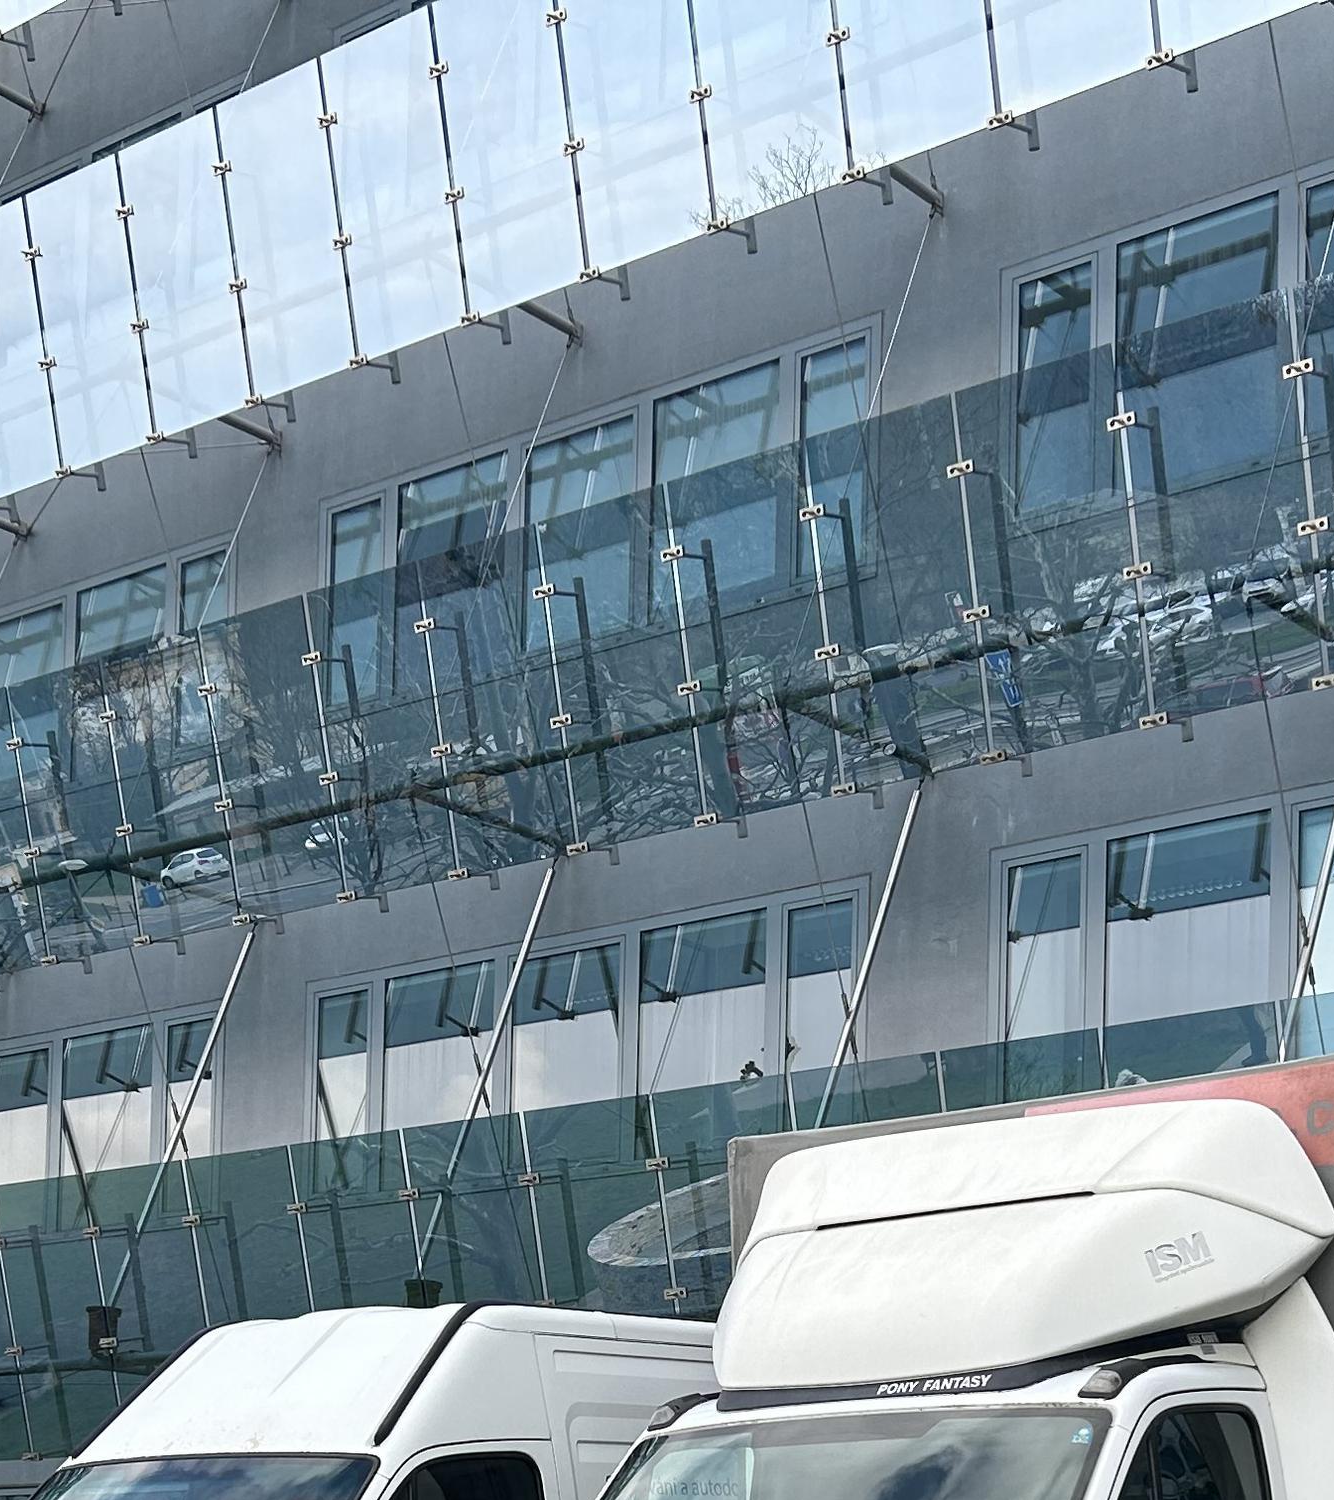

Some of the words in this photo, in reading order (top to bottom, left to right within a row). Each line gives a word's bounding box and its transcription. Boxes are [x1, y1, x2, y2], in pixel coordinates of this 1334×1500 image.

[1145, 1231, 1212, 1276] ISM
[876, 1381, 920, 1395] PONY
[922, 1374, 993, 1392] FANTASY
